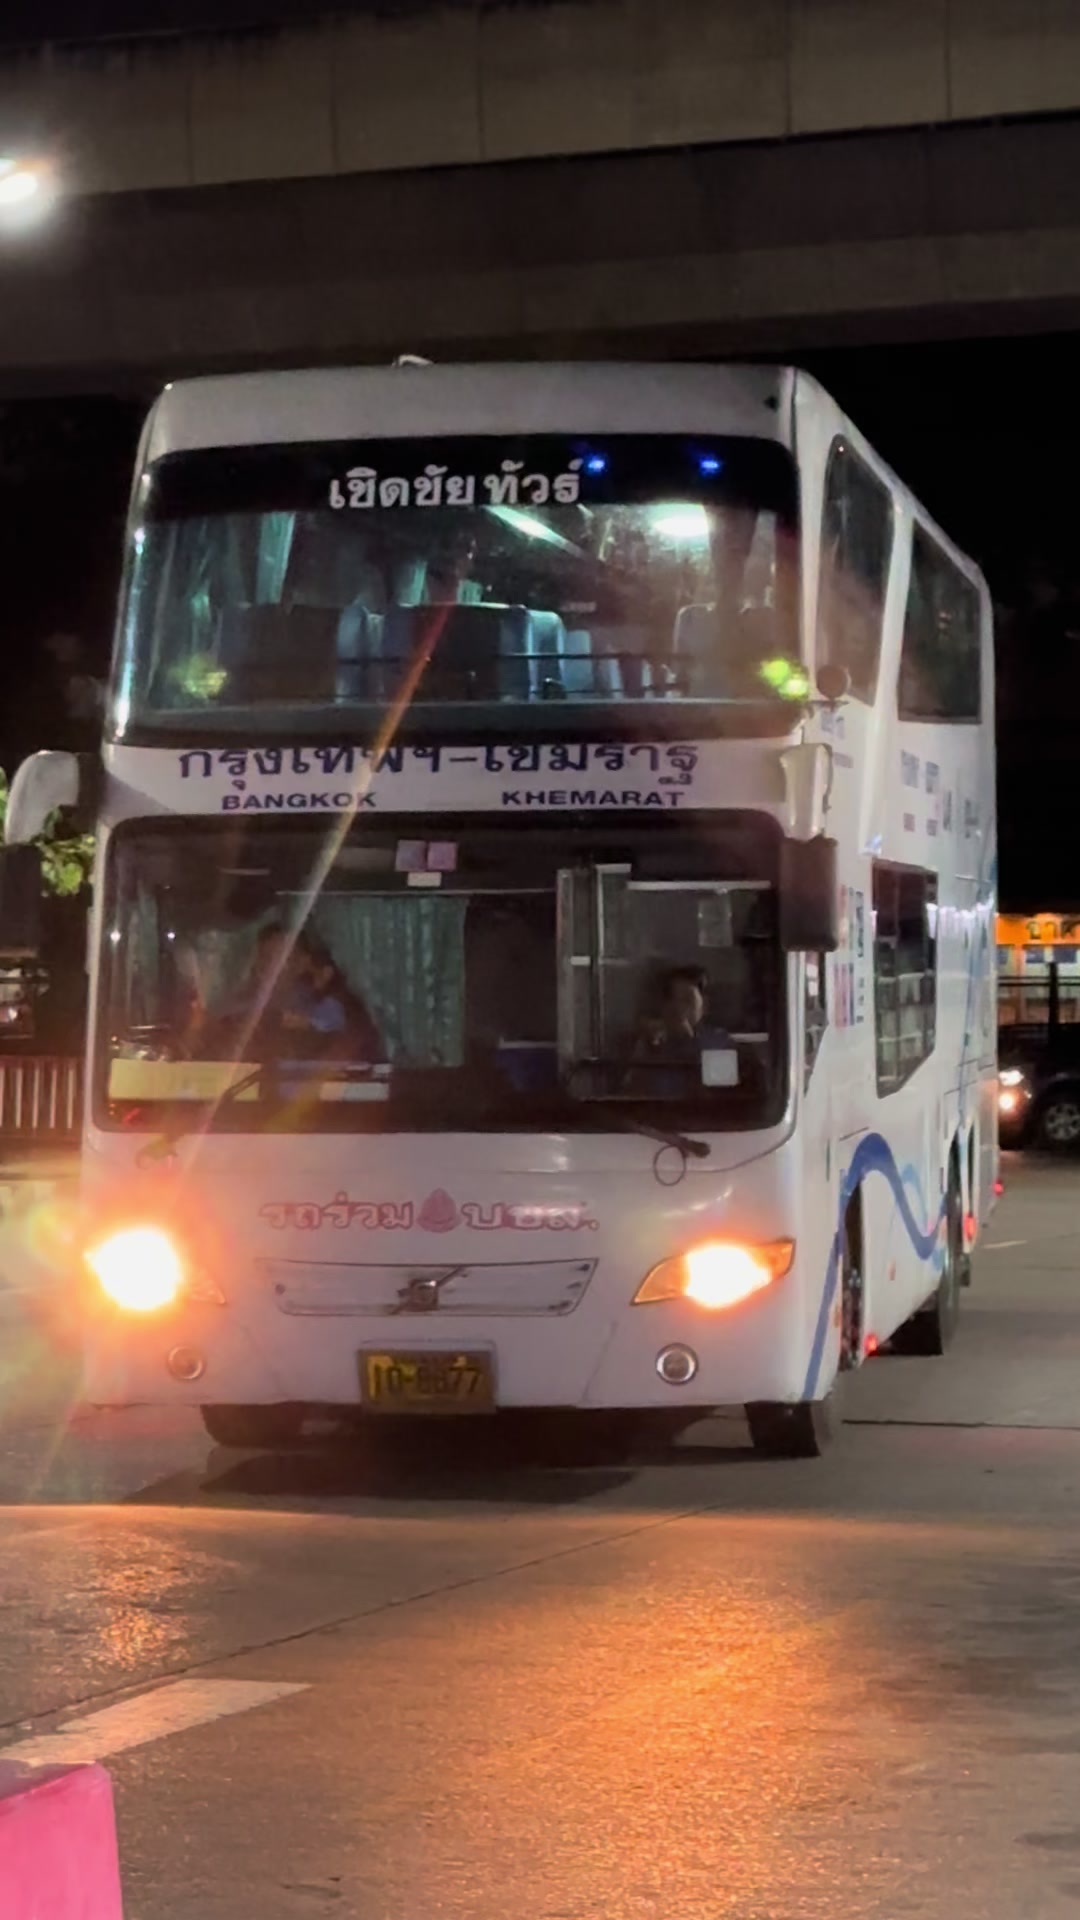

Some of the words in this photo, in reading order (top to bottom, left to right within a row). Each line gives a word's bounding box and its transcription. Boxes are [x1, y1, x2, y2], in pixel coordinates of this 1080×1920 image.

[483, 459, 583, 505] ทัวร์
[221, 792, 377, 811] BANGKOK
[501, 790, 685, 807] KHEMARAT
[258, 1190, 414, 1231] รถร่วม
